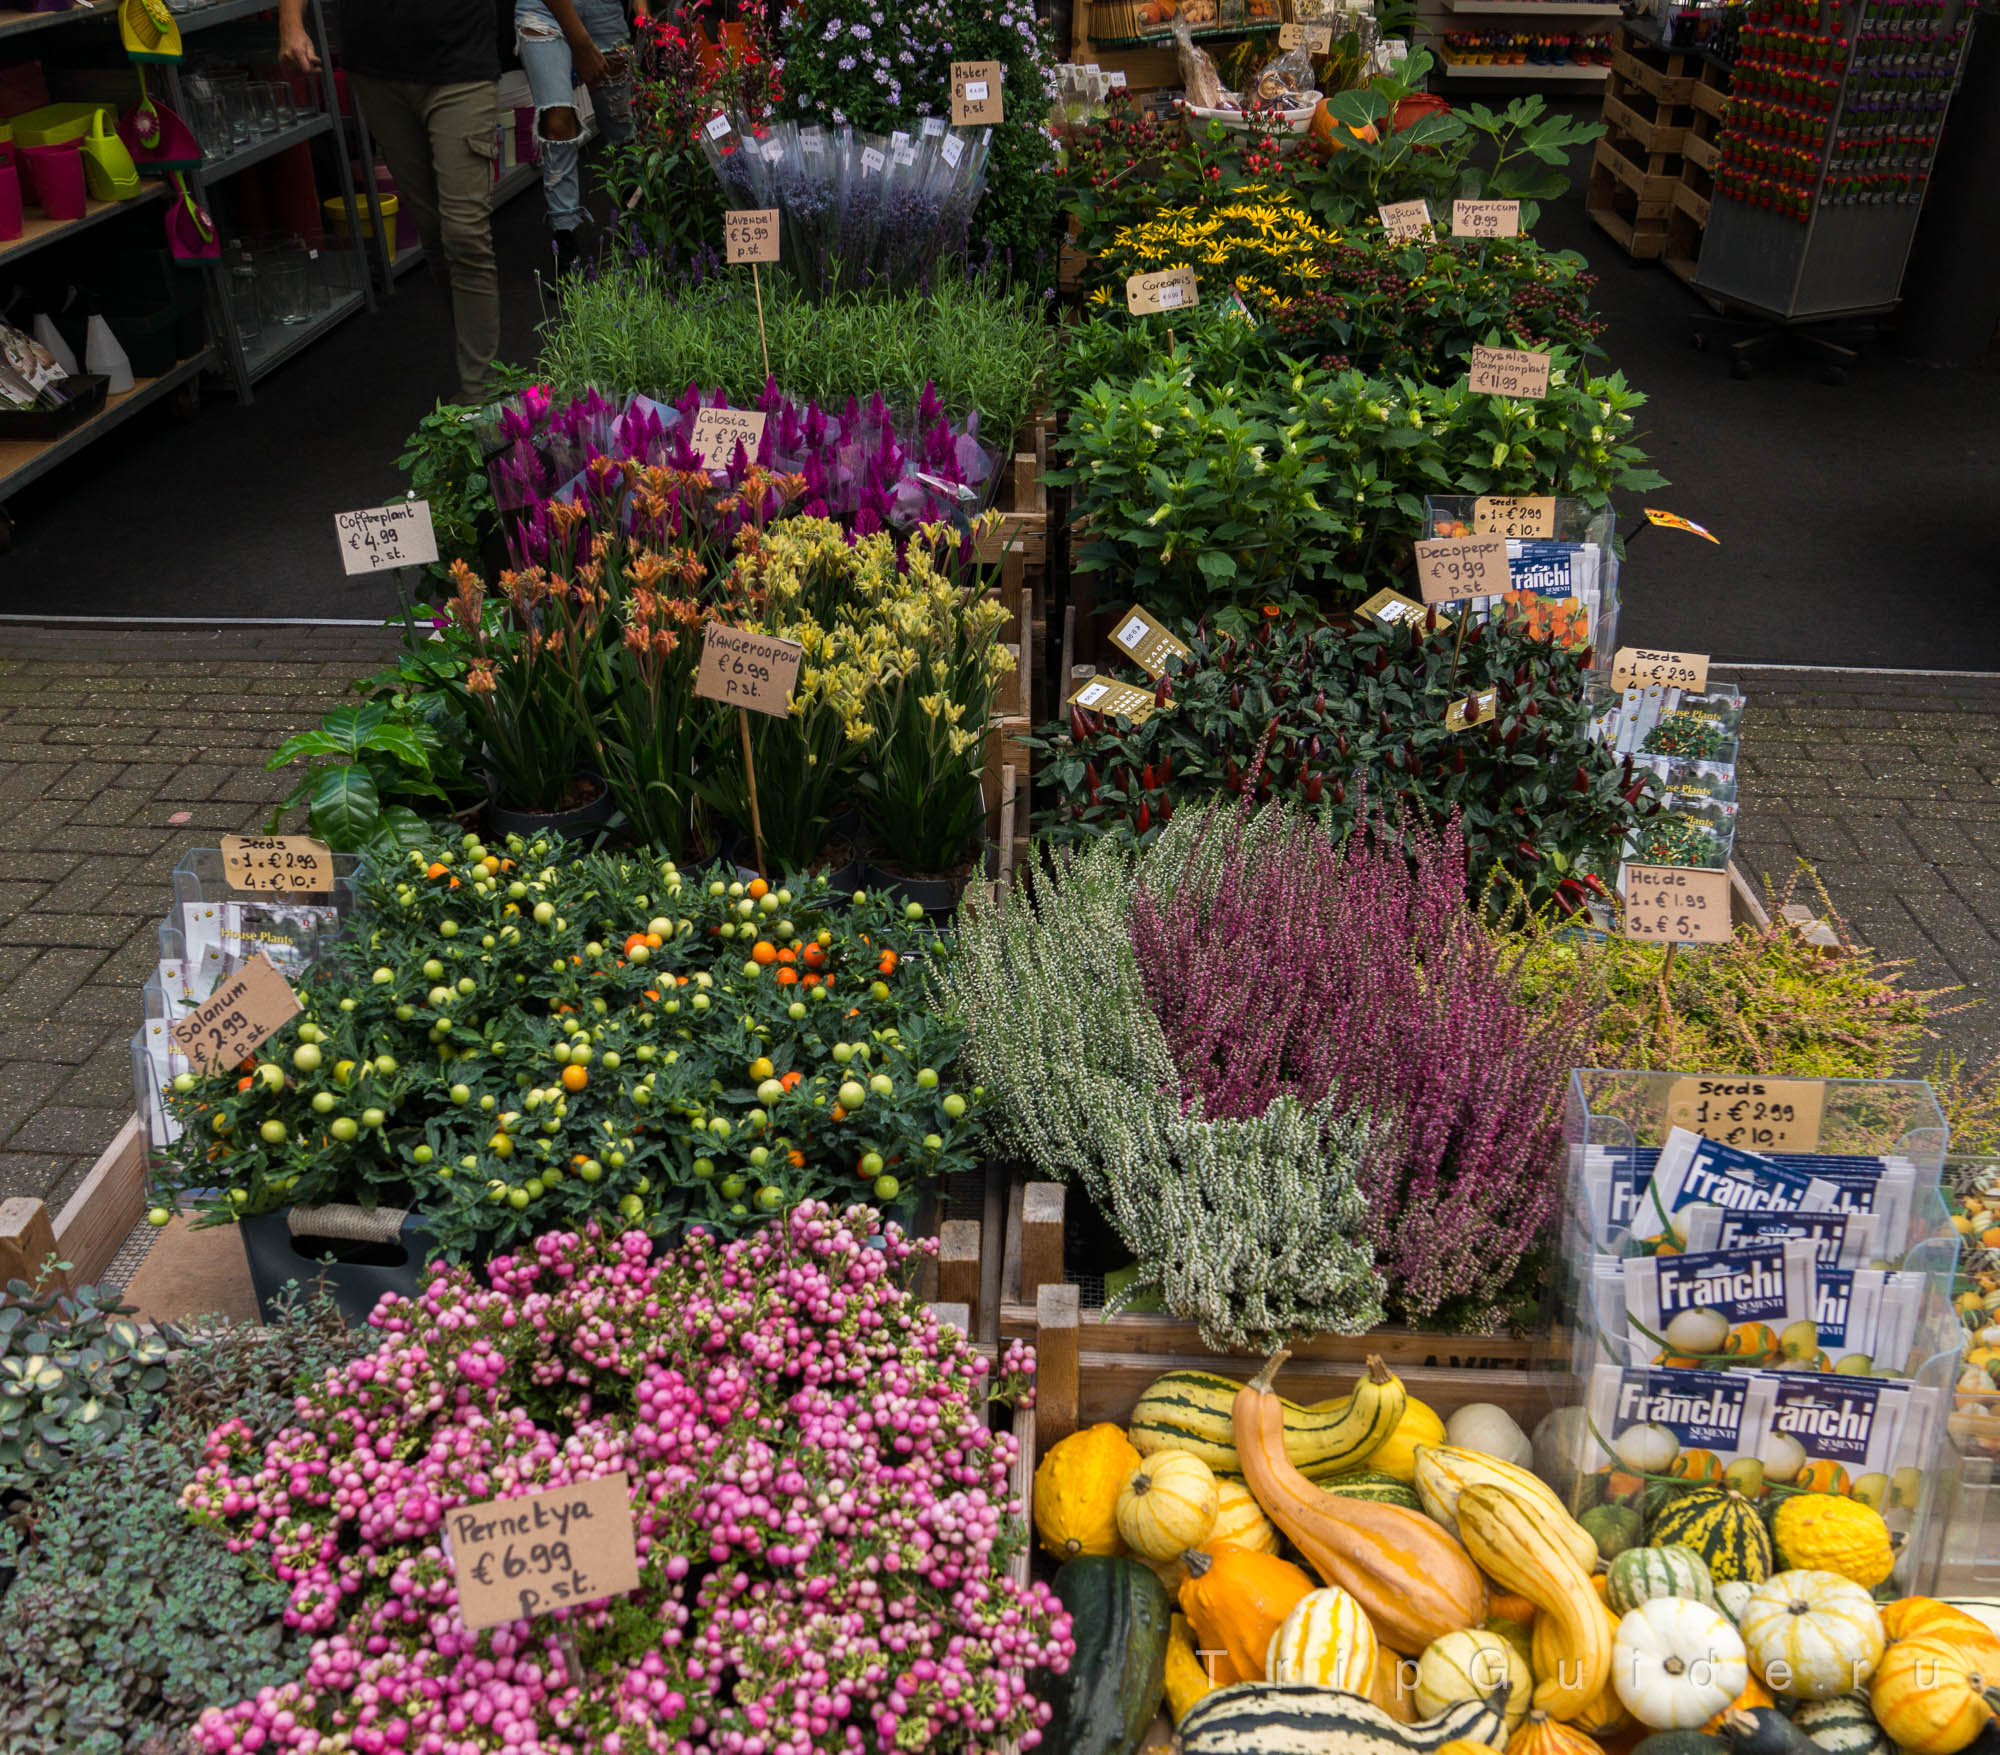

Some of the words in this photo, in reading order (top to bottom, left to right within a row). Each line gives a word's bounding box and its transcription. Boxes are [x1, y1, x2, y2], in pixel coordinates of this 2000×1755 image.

[1457, 202, 1518, 215] Hypericum
[699, 410, 750, 427] Celosia
[1418, 541, 1500, 560] Decopeper
[1636, 650, 1682, 663] Seeds
[1691, 709, 1722, 722] Plants
[1681, 784, 1712, 796] Plants
[1631, 868, 1687, 887] Heide
[221, 927, 258, 942] House
[260, 931, 295, 945] Plants
[175, 980, 248, 1044] Solanum
[1698, 1081, 1767, 1096] Seeds
[1683, 1153, 1804, 1212] Franchi
[1660, 1257, 1783, 1310] Franchi
[1735, 1298, 1784, 1310] SEMENTI
[1618, 1382, 1744, 1429] Franchi
[1773, 1398, 1875, 1441] ranchi
[1688, 1426, 1737, 1440] SEMENTI
[1817, 1436, 1865, 1452] SEMENTI
[454, 1501, 595, 1545] Pernetya
